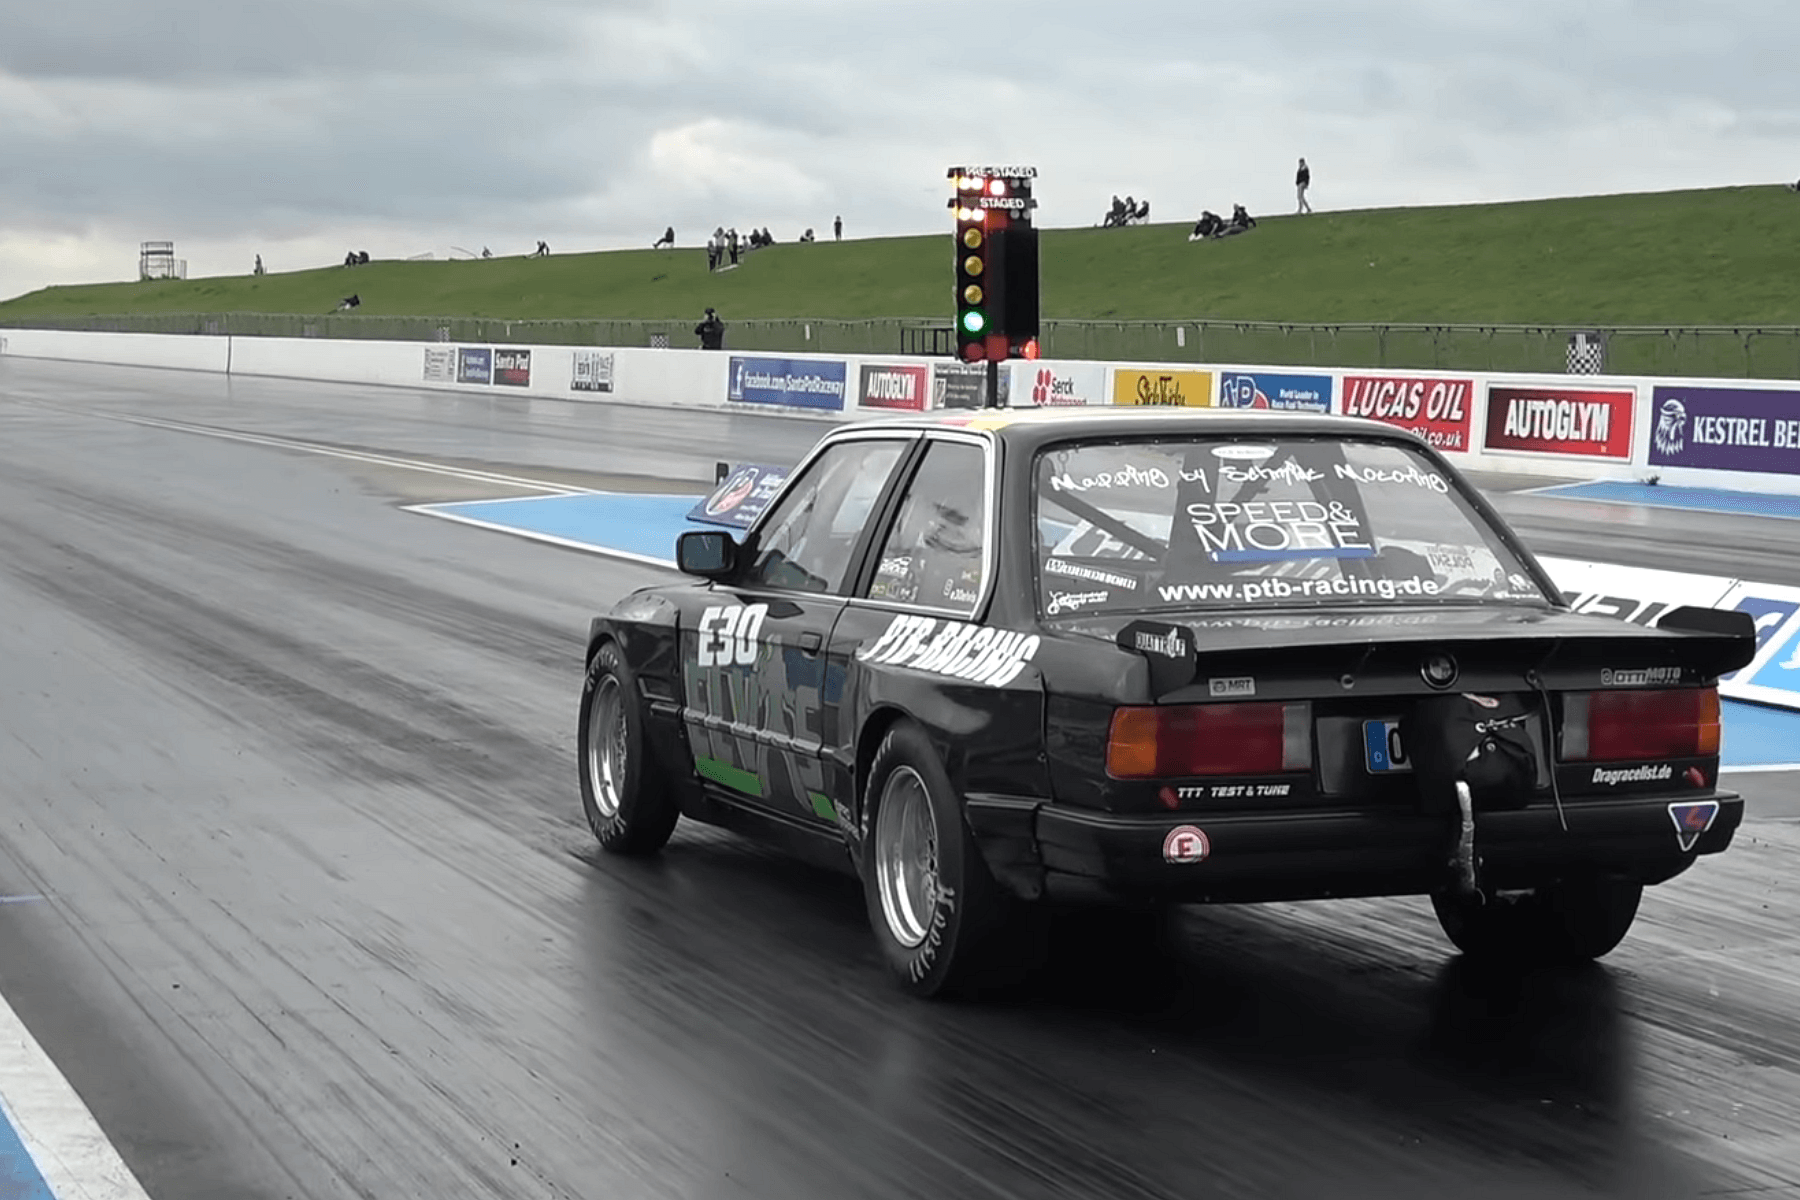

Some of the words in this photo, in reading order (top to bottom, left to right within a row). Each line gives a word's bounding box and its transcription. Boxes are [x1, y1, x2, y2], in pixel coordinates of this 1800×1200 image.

[965, 165, 1034, 178] PRE-STAGED
[979, 197, 1025, 209] STAGED
[867, 371, 917, 400] AUTOGLYM
[1051, 376, 1074, 395] Serck
[1346, 380, 1425, 419] LUCAS
[1426, 381, 1466, 421] OIL
[1503, 398, 1611, 442] AUTOGLYM
[1692, 415, 1770, 447] KESTREL
[1178, 467, 1211, 493] by
[1193, 522, 1372, 552] MORE
[1158, 575, 1439, 602] www.ptb-racing.de
[698, 603, 769, 666] E30
[856, 614, 1041, 687] PTB-RACING
[1592, 764, 1673, 786] Dragracelist.de
[1177, 787, 1204, 798] TTT
[1210, 786, 1245, 797] TEST
[1246, 786, 1254, 797] &
[1256, 785, 1291, 796] TUNE
[1177, 837, 1194, 858] E
